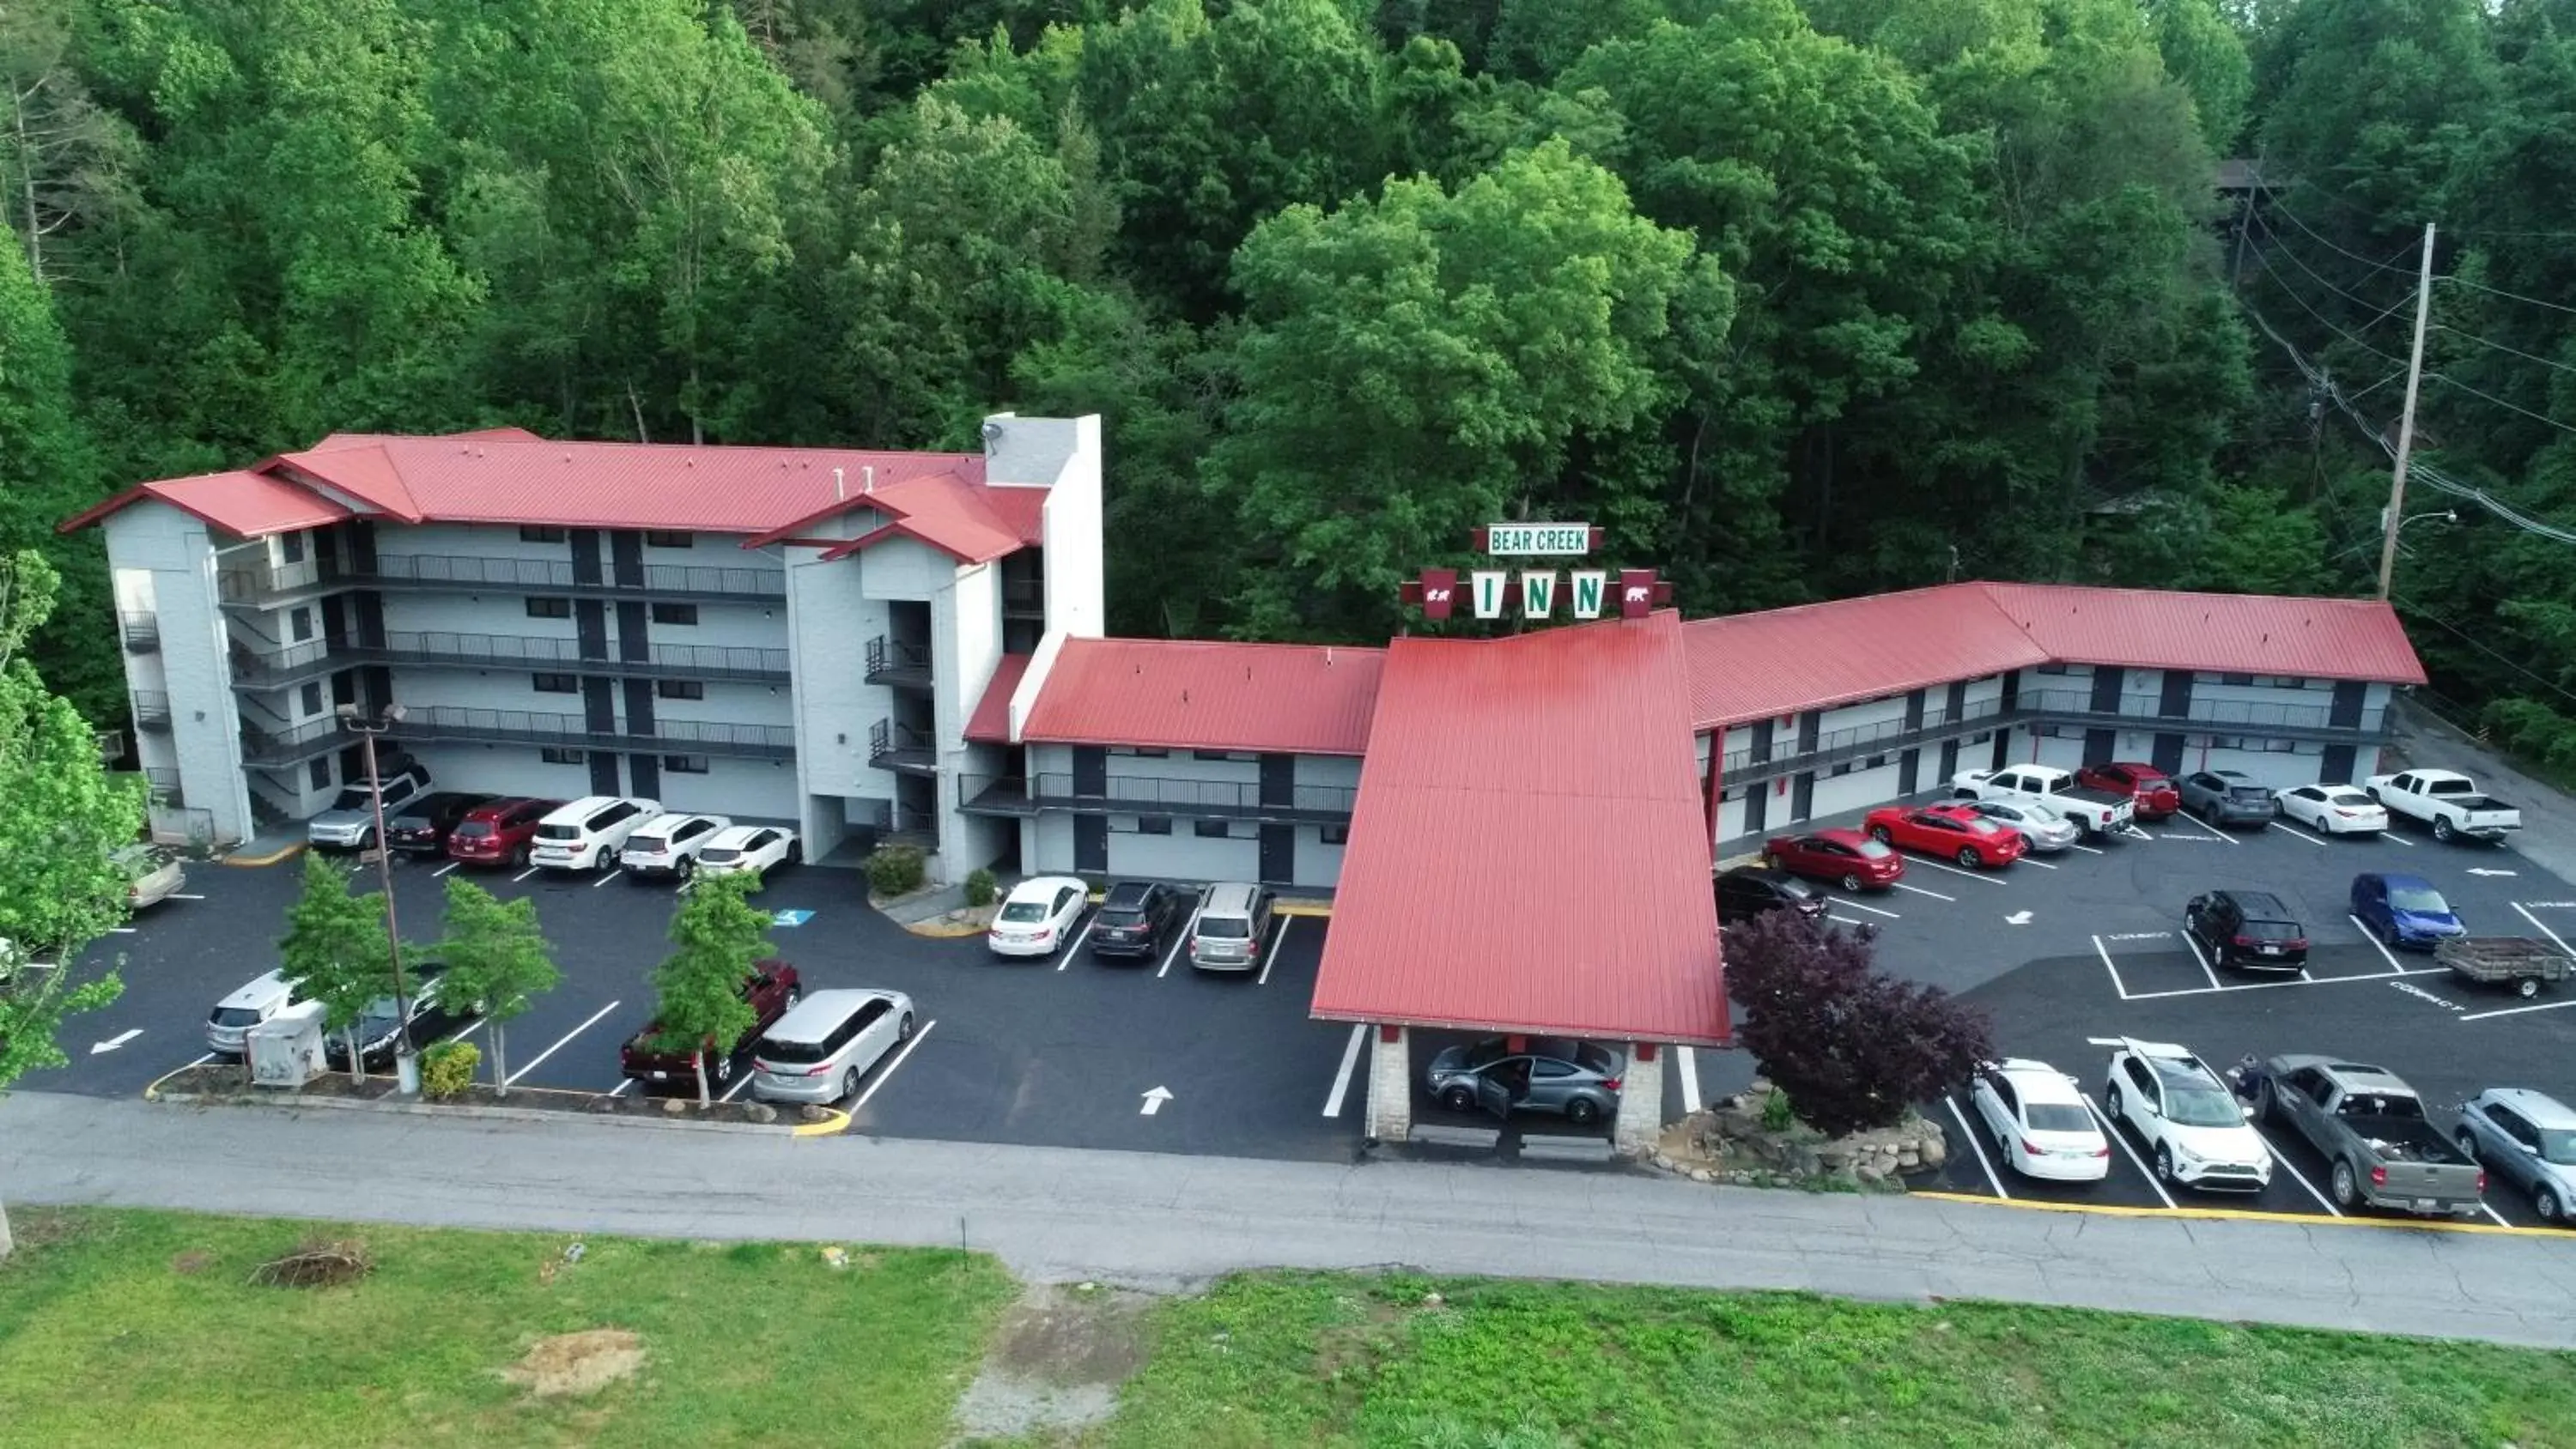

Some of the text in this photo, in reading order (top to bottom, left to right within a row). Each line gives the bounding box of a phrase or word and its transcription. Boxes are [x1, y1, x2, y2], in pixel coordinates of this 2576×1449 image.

[1492, 530, 1584, 550] BEAR CREEK
[1484, 578, 1598, 612] INN
